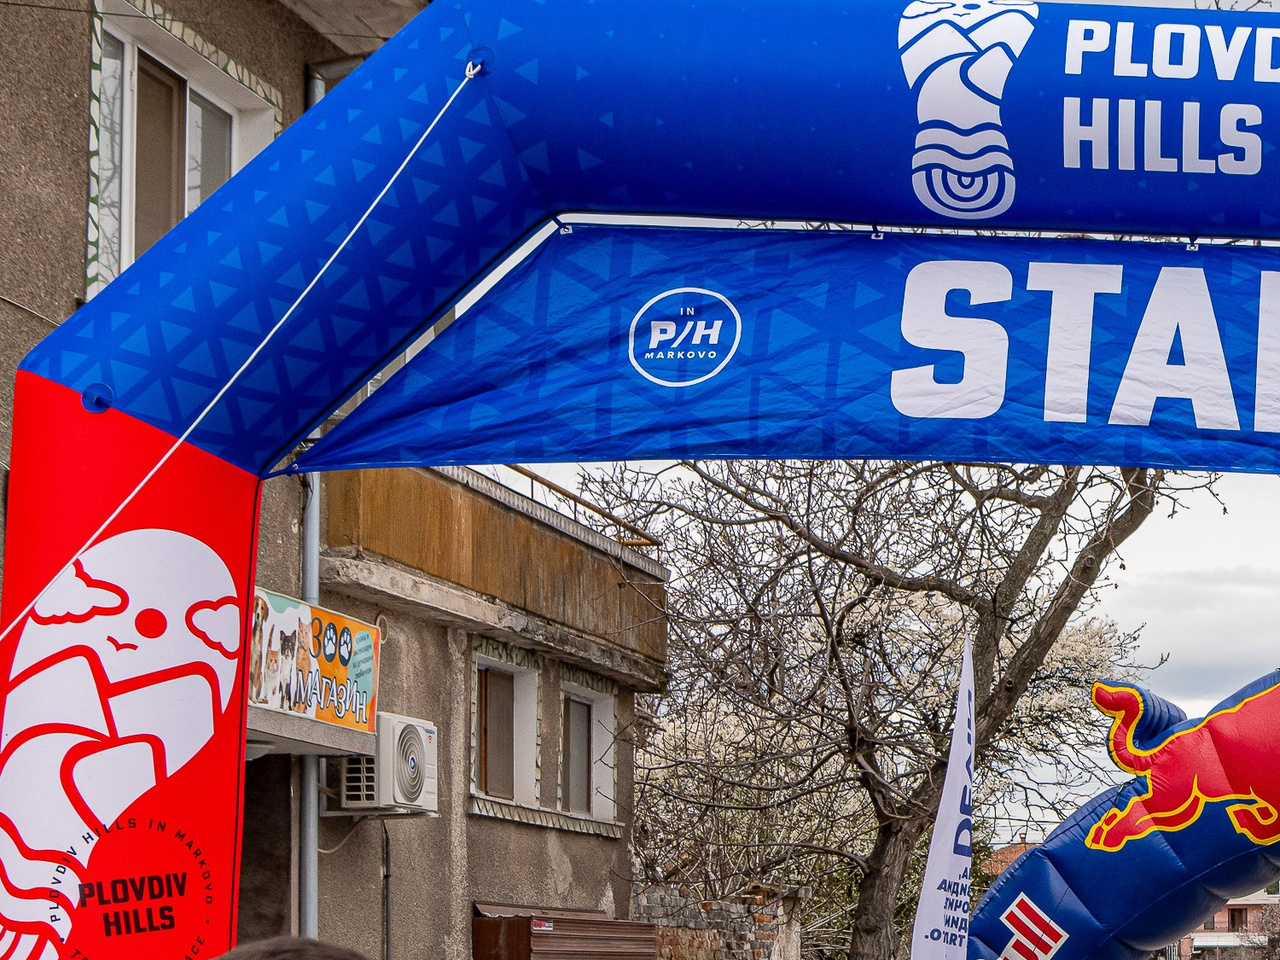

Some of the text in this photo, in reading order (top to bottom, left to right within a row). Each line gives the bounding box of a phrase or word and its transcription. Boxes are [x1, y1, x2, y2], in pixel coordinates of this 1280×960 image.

[1063, 97, 1263, 175] HILLS
[680, 307, 695, 316] IN
[648, 320, 724, 349] P/H
[644, 351, 717, 359] MARKOVO
[296, 668, 368, 724] МАГАЗИН
[49, 818, 213, 923] PLOVDIV HILLS IN MARKOVO
[78, 872, 188, 908] PLOVDIV
[102, 905, 176, 937] HILLS
